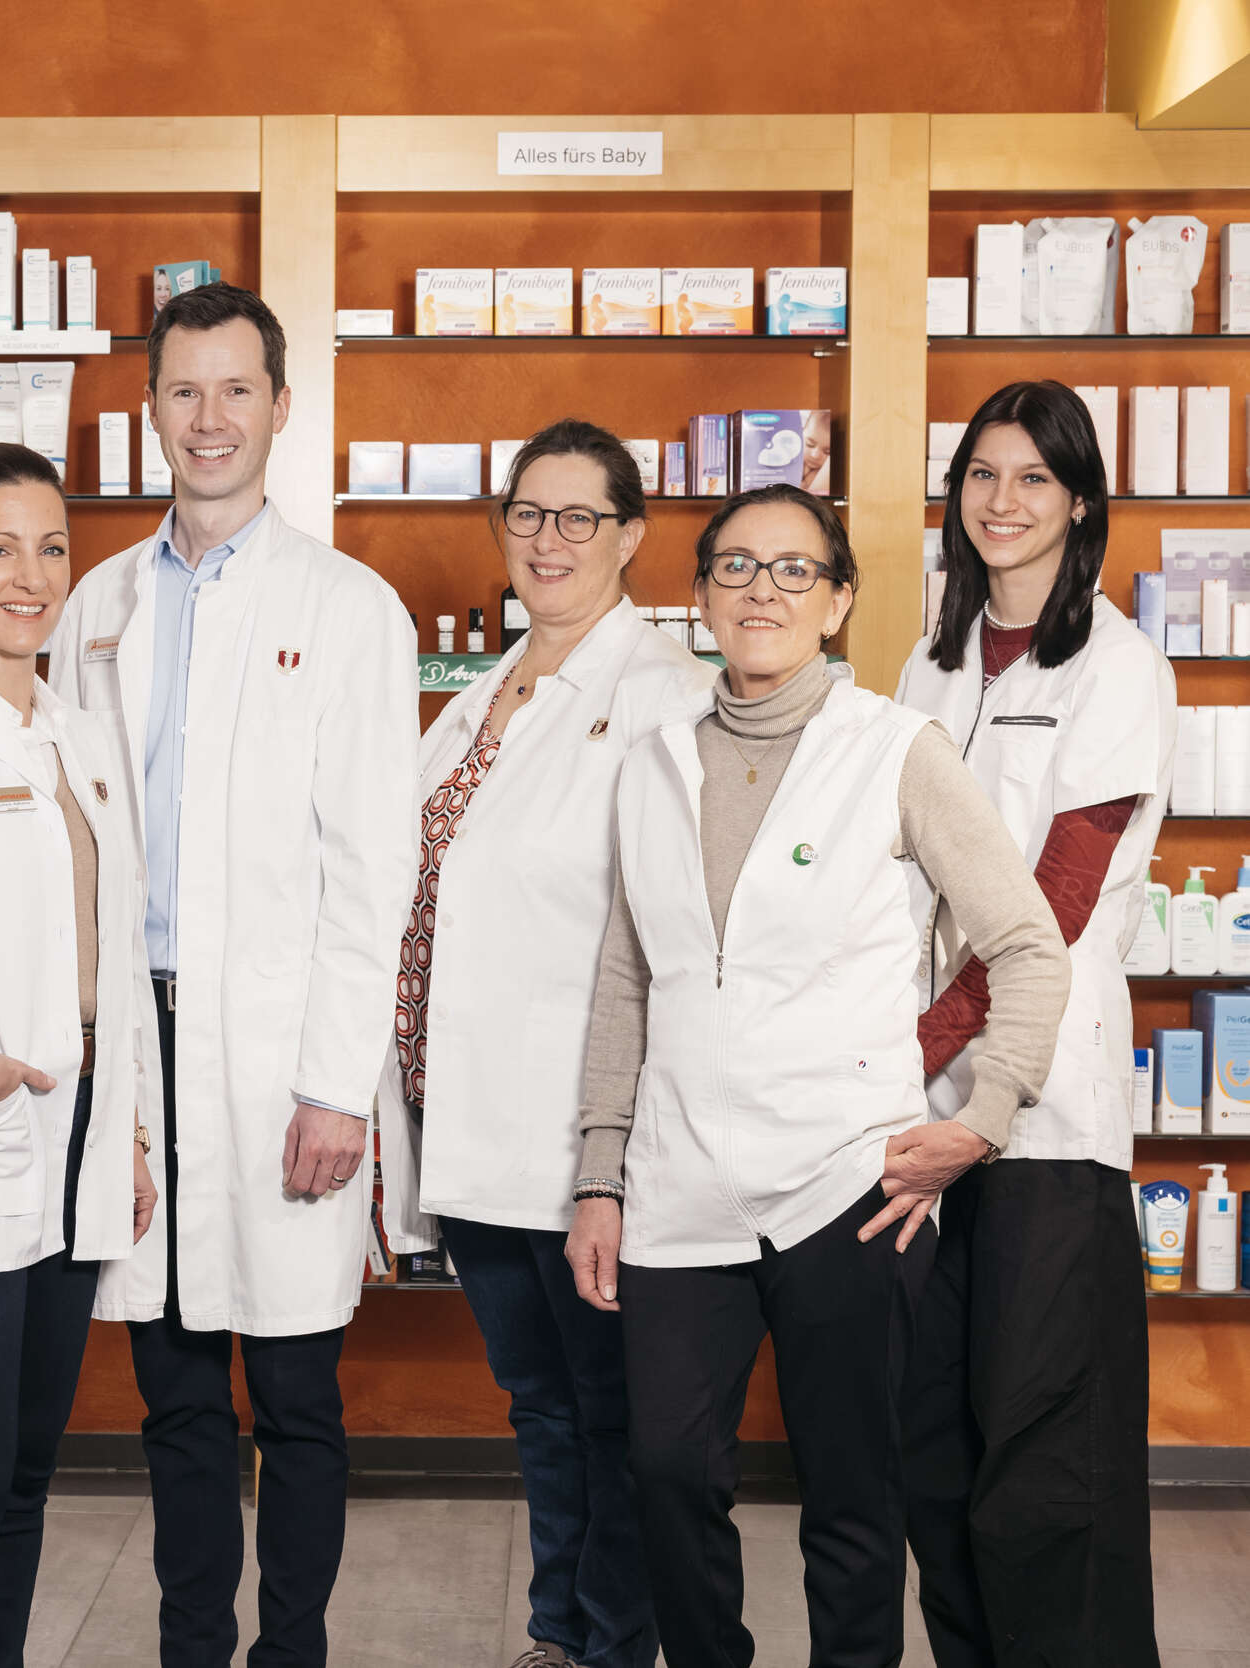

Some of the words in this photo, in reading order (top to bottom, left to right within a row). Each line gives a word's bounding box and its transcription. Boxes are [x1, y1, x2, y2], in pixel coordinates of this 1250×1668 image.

[514, 148, 557, 163] Alles
[563, 147, 596, 164] fürs
[602, 147, 647, 167] Baby
[425, 273, 487, 293] femibion
[504, 273, 566, 293] femibion
[591, 273, 654, 293] femibion
[678, 273, 740, 294] femibion
[777, 273, 839, 293] femibion
[646, 292, 655, 304] 2
[733, 292, 742, 303] 2
[833, 291, 842, 303] 3
